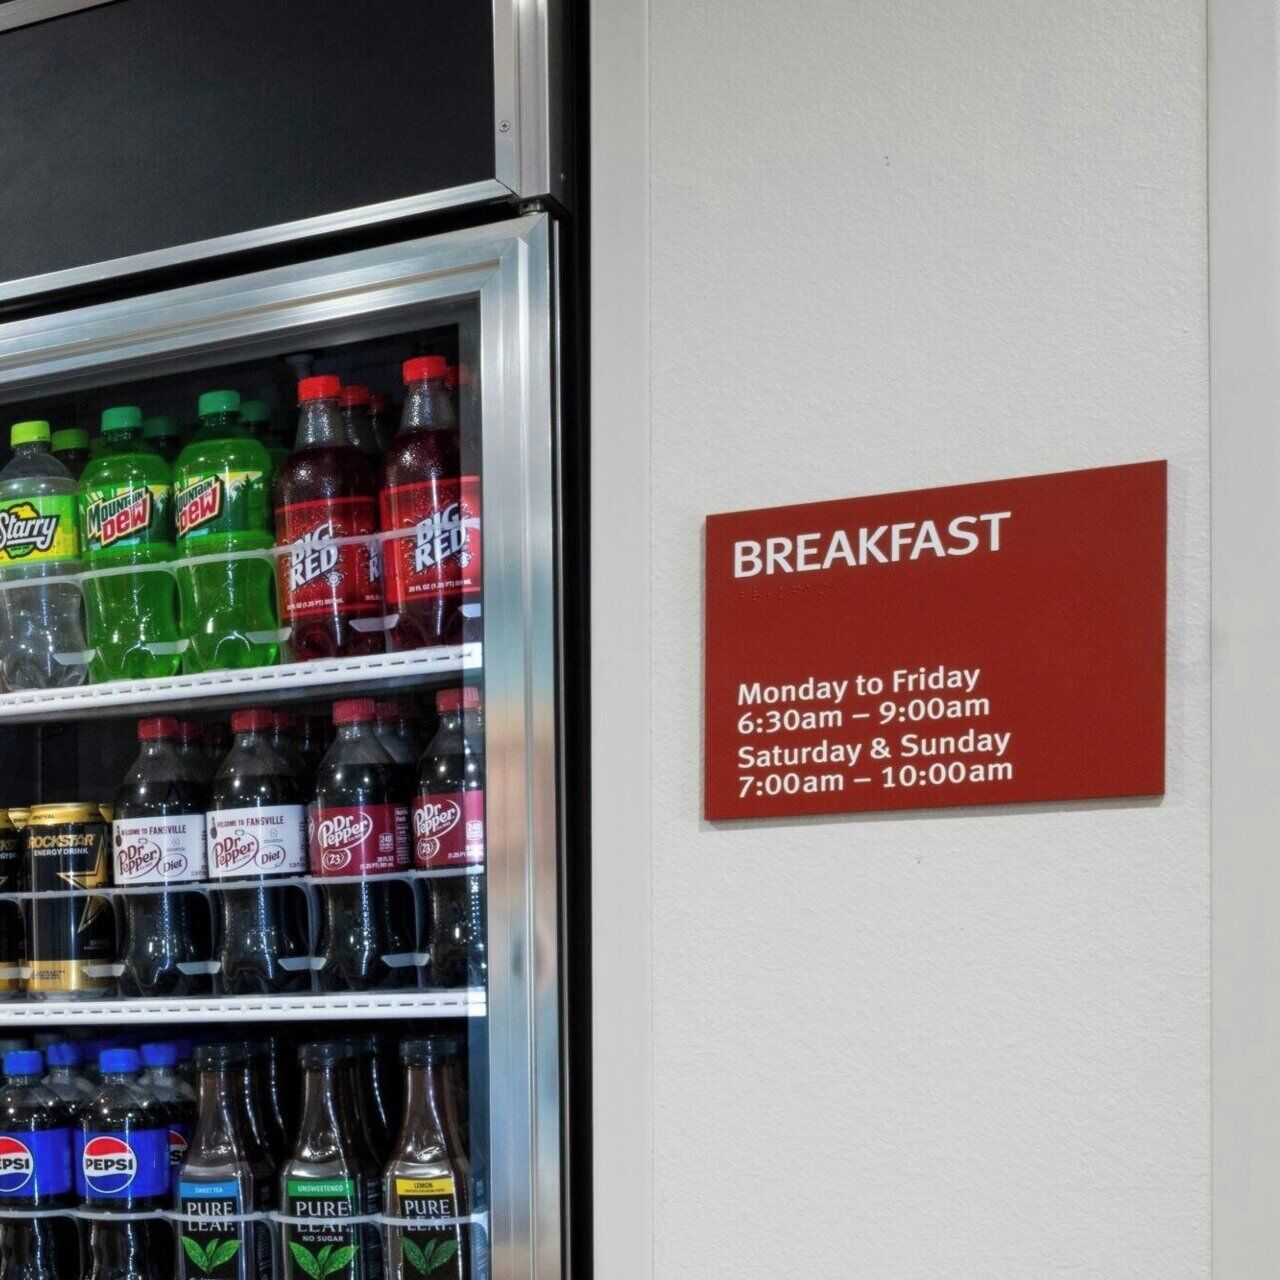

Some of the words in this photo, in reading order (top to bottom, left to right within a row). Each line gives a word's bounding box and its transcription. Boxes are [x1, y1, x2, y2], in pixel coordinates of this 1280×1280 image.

[415, 502, 462, 548] BIG
[290, 522, 331, 564] BIG
[414, 526, 467, 572] RED
[733, 512, 1012, 579] BREAKFAST
[290, 545, 339, 591] RED
[738, 677, 848, 706] Monday
[856, 674, 883, 697] to
[893, 666, 980, 694] Friday
[738, 707, 843, 735] 6:30am
[878, 697, 990, 726] 9:00am
[738, 739, 862, 770] Saturday
[870, 737, 891, 759] &
[901, 729, 1011, 757] Sunday
[738, 773, 844, 799] 7:00am
[881, 762, 1013, 790] 10:00am
[422, 803, 442, 820] Dr
[246, 815, 284, 826] FANSVILLE
[333, 815, 354, 832] Dr
[416, 808, 456, 838] Pepper
[149, 824, 186, 835] FANSVILLE
[322, 819, 368, 849] Pepper
[28, 833, 96, 848] ROCKSTAR
[223, 835, 242, 850] Dr
[421, 843, 431, 853] 23
[33, 848, 62, 857] ENERGY
[62, 847, 89, 855] DRINK
[127, 844, 145, 859] Dr
[213, 841, 255, 869] Pepper
[261, 850, 281, 865] Diet
[329, 853, 341, 864] 23
[118, 850, 157, 876] Pepper
[162, 858, 182, 874] Diet
[85, 1158, 134, 1171] PEPSI
[297, 1184, 344, 1193] UNSWEETENED
[414, 1182, 434, 1190] LEMON
[187, 1202, 234, 1217] PURE
[296, 1201, 351, 1217] PURE
[405, 1200, 451, 1215] PURE
[302, 1235, 315, 1243] NO
[316, 1235, 344, 1243] SUGAR
